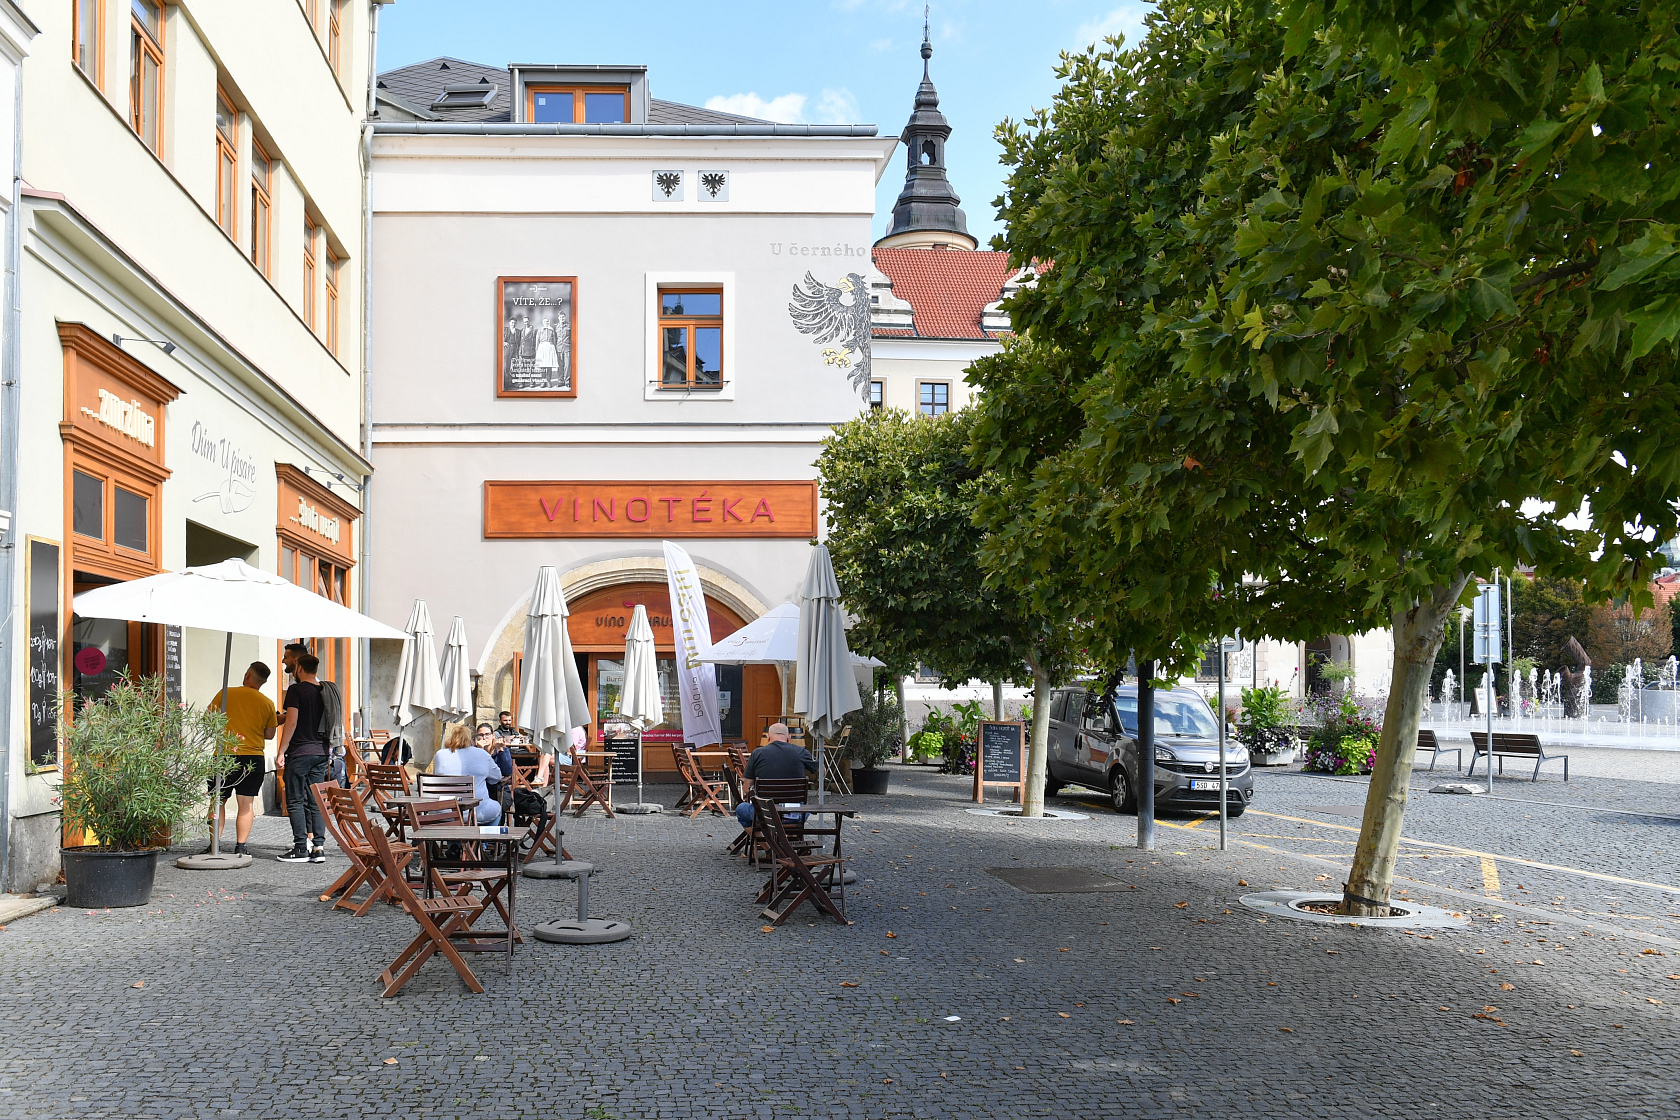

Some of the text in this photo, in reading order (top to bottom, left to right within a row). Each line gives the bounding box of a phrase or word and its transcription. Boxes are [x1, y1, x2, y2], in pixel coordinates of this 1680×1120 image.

[770, 242, 867, 257] U černého
[512, 295, 537, 307] VÍTE,
[539, 490, 775, 522] VINOTÉKA
